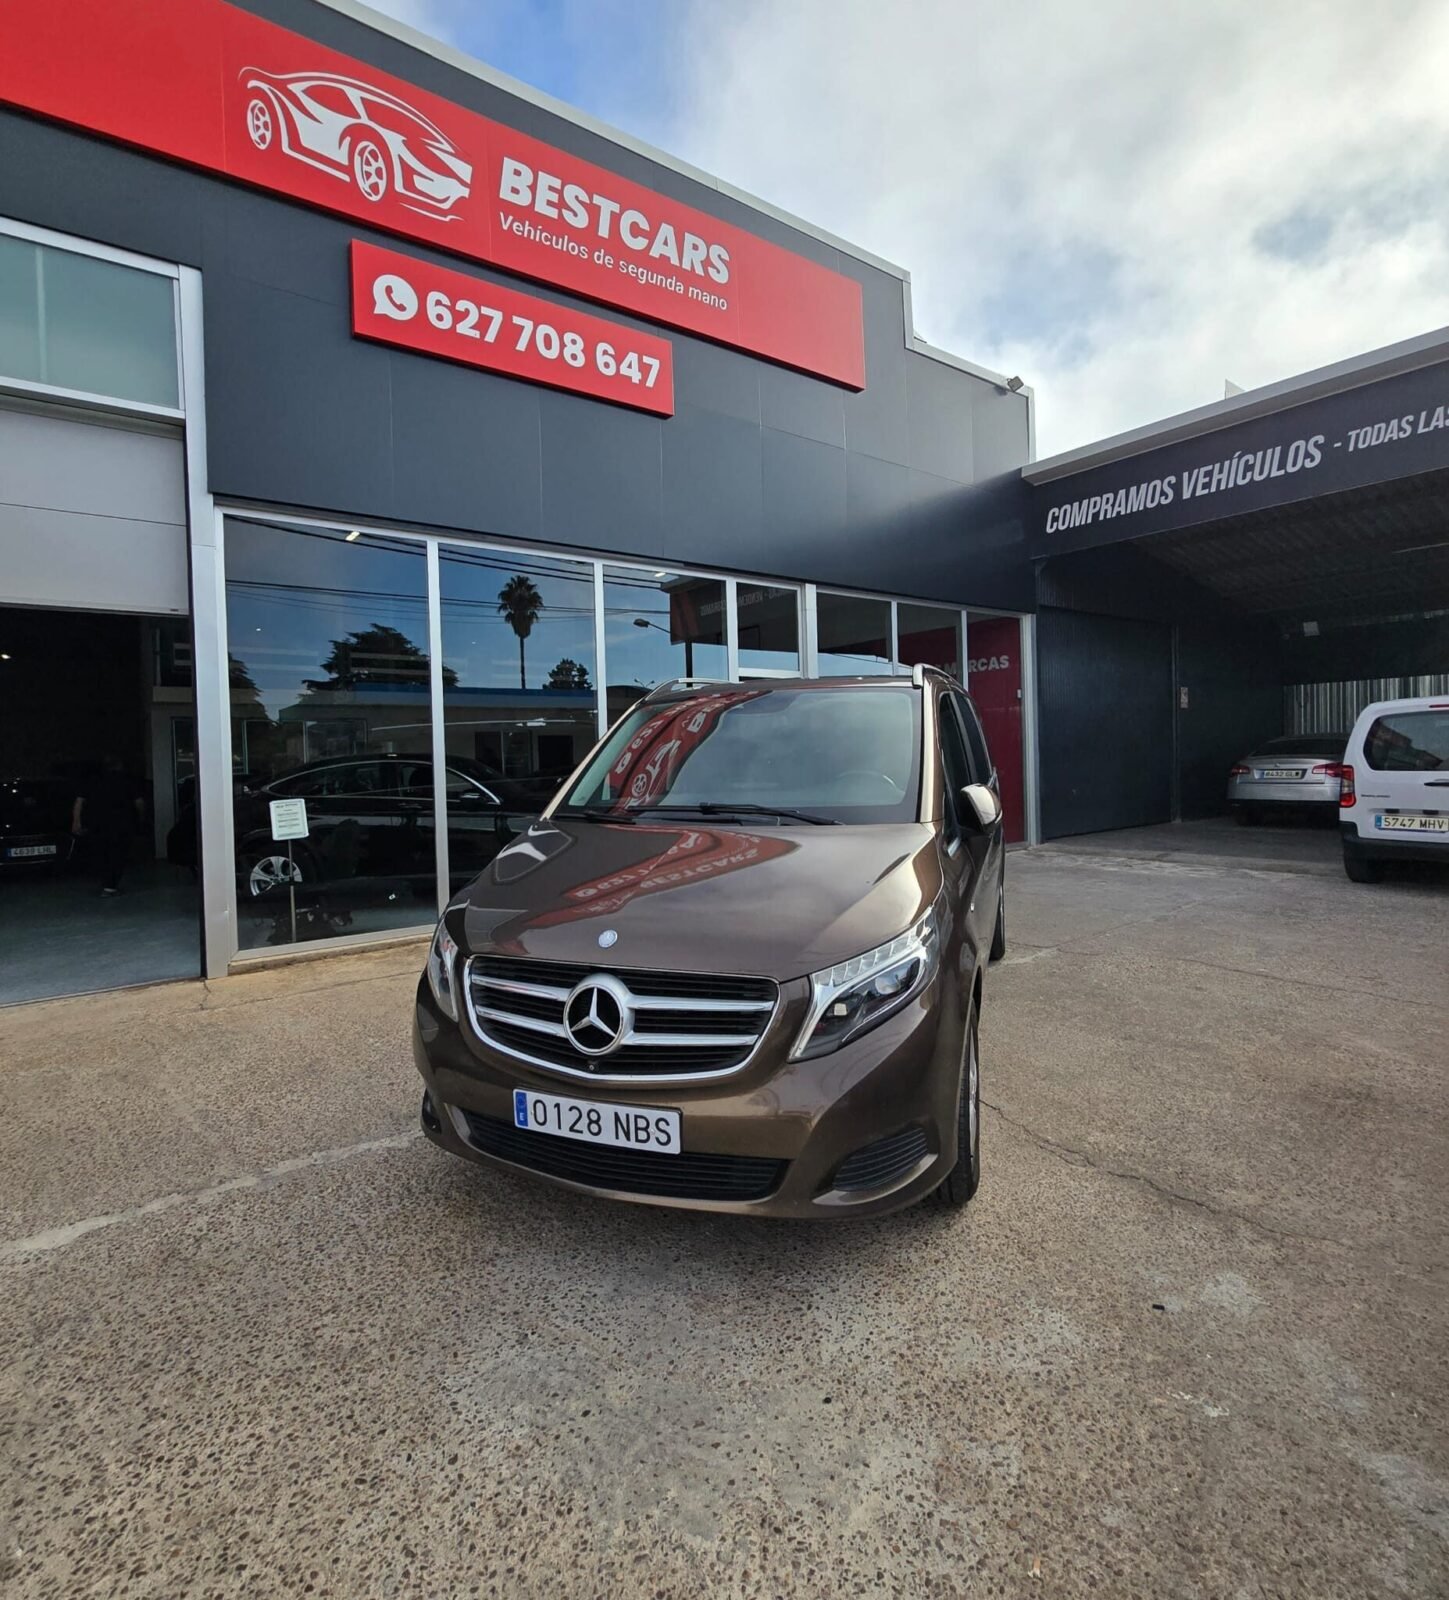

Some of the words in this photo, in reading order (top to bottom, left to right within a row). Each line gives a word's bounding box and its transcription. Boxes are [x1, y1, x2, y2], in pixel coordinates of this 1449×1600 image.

[499, 157, 729, 284] BESTCARS
[499, 212, 588, 259] Vehículos
[594, 249, 614, 268] de
[619, 260, 684, 294] segunda
[688, 284, 728, 310] mano
[426, 291, 503, 343] 627
[512, 315, 586, 368] 708
[596, 342, 660, 388] 647
[1046, 475, 1176, 534] COMPRAMOS
[1182, 434, 1325, 500] VEHÍCULOS
[1347, 415, 1414, 453] TODAS
[1417, 404, 1449, 434] LA
[944, 655, 1009, 674] MRCAS
[1384, 817, 1415, 828] 5747
[1420, 819, 1445, 830] MHV
[533, 1099, 602, 1136] 0128
[614, 1111, 672, 1146] NBS
